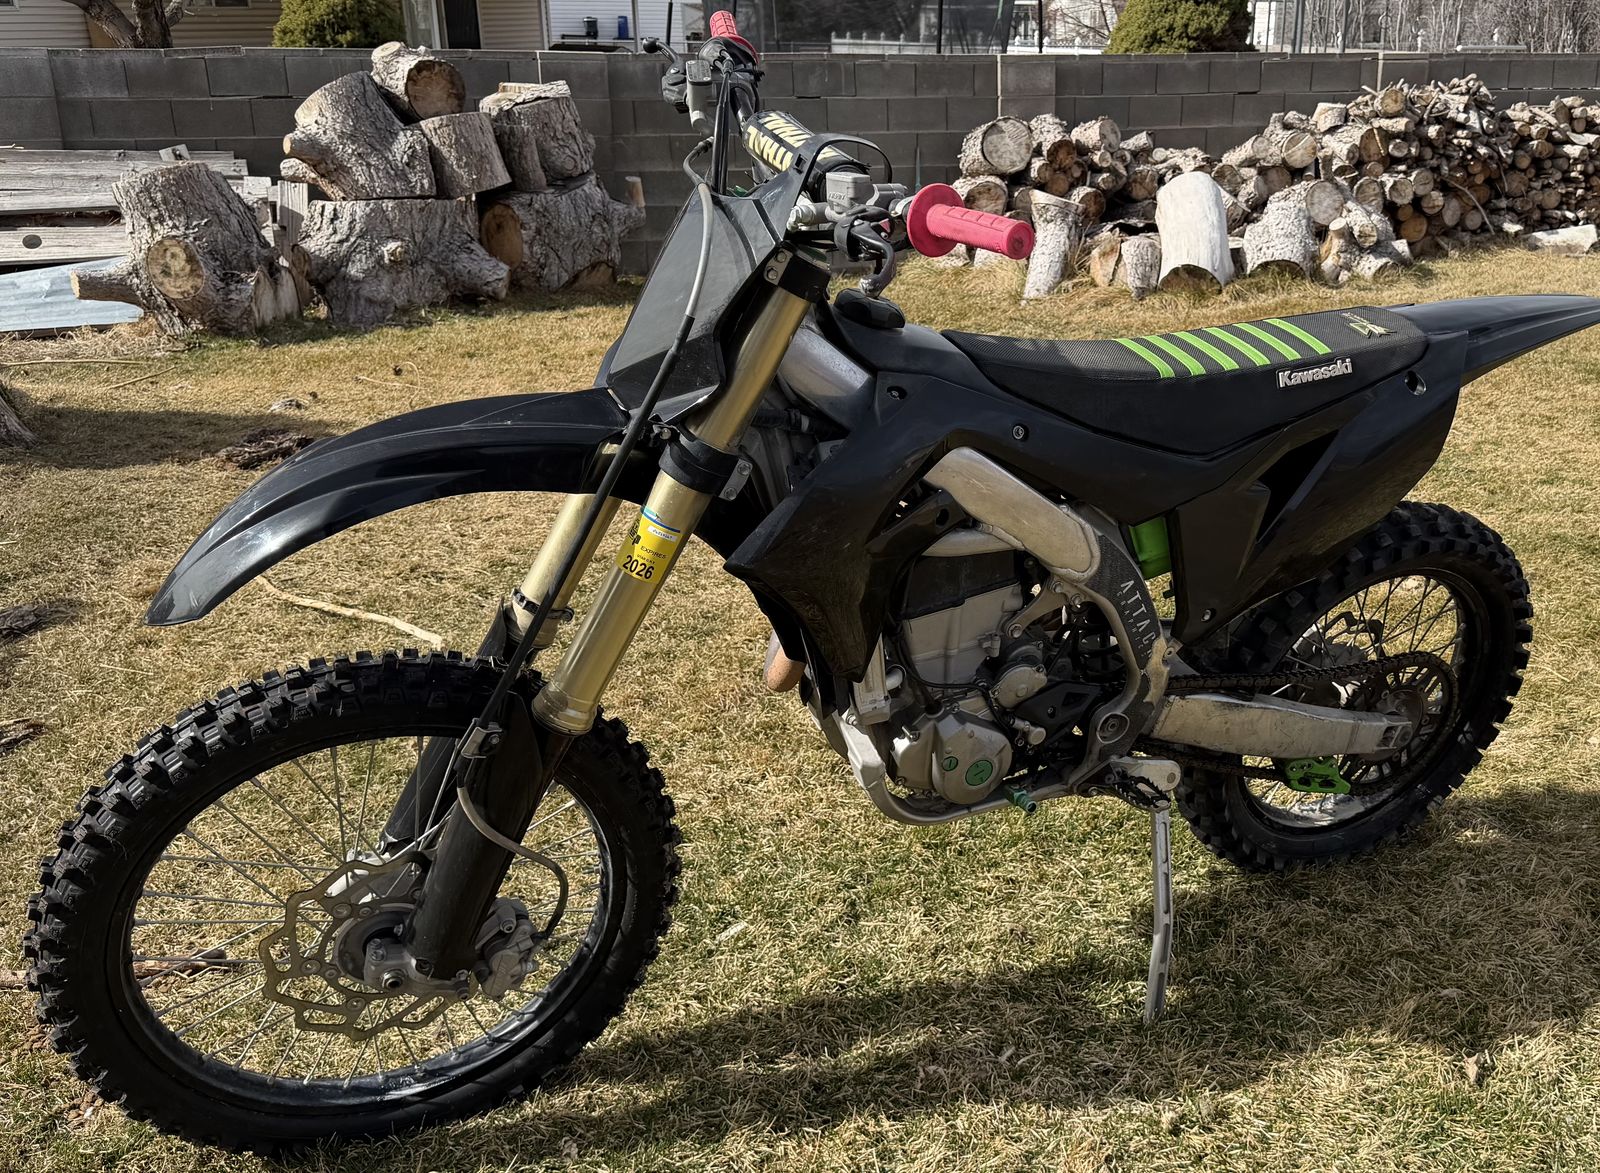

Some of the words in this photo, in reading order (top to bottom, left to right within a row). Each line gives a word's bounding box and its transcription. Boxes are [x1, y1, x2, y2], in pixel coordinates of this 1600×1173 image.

[1278, 358, 1353, 388] Kawasaki
[640, 546, 668, 559] EXPIRES
[622, 555, 655, 580] 2026
